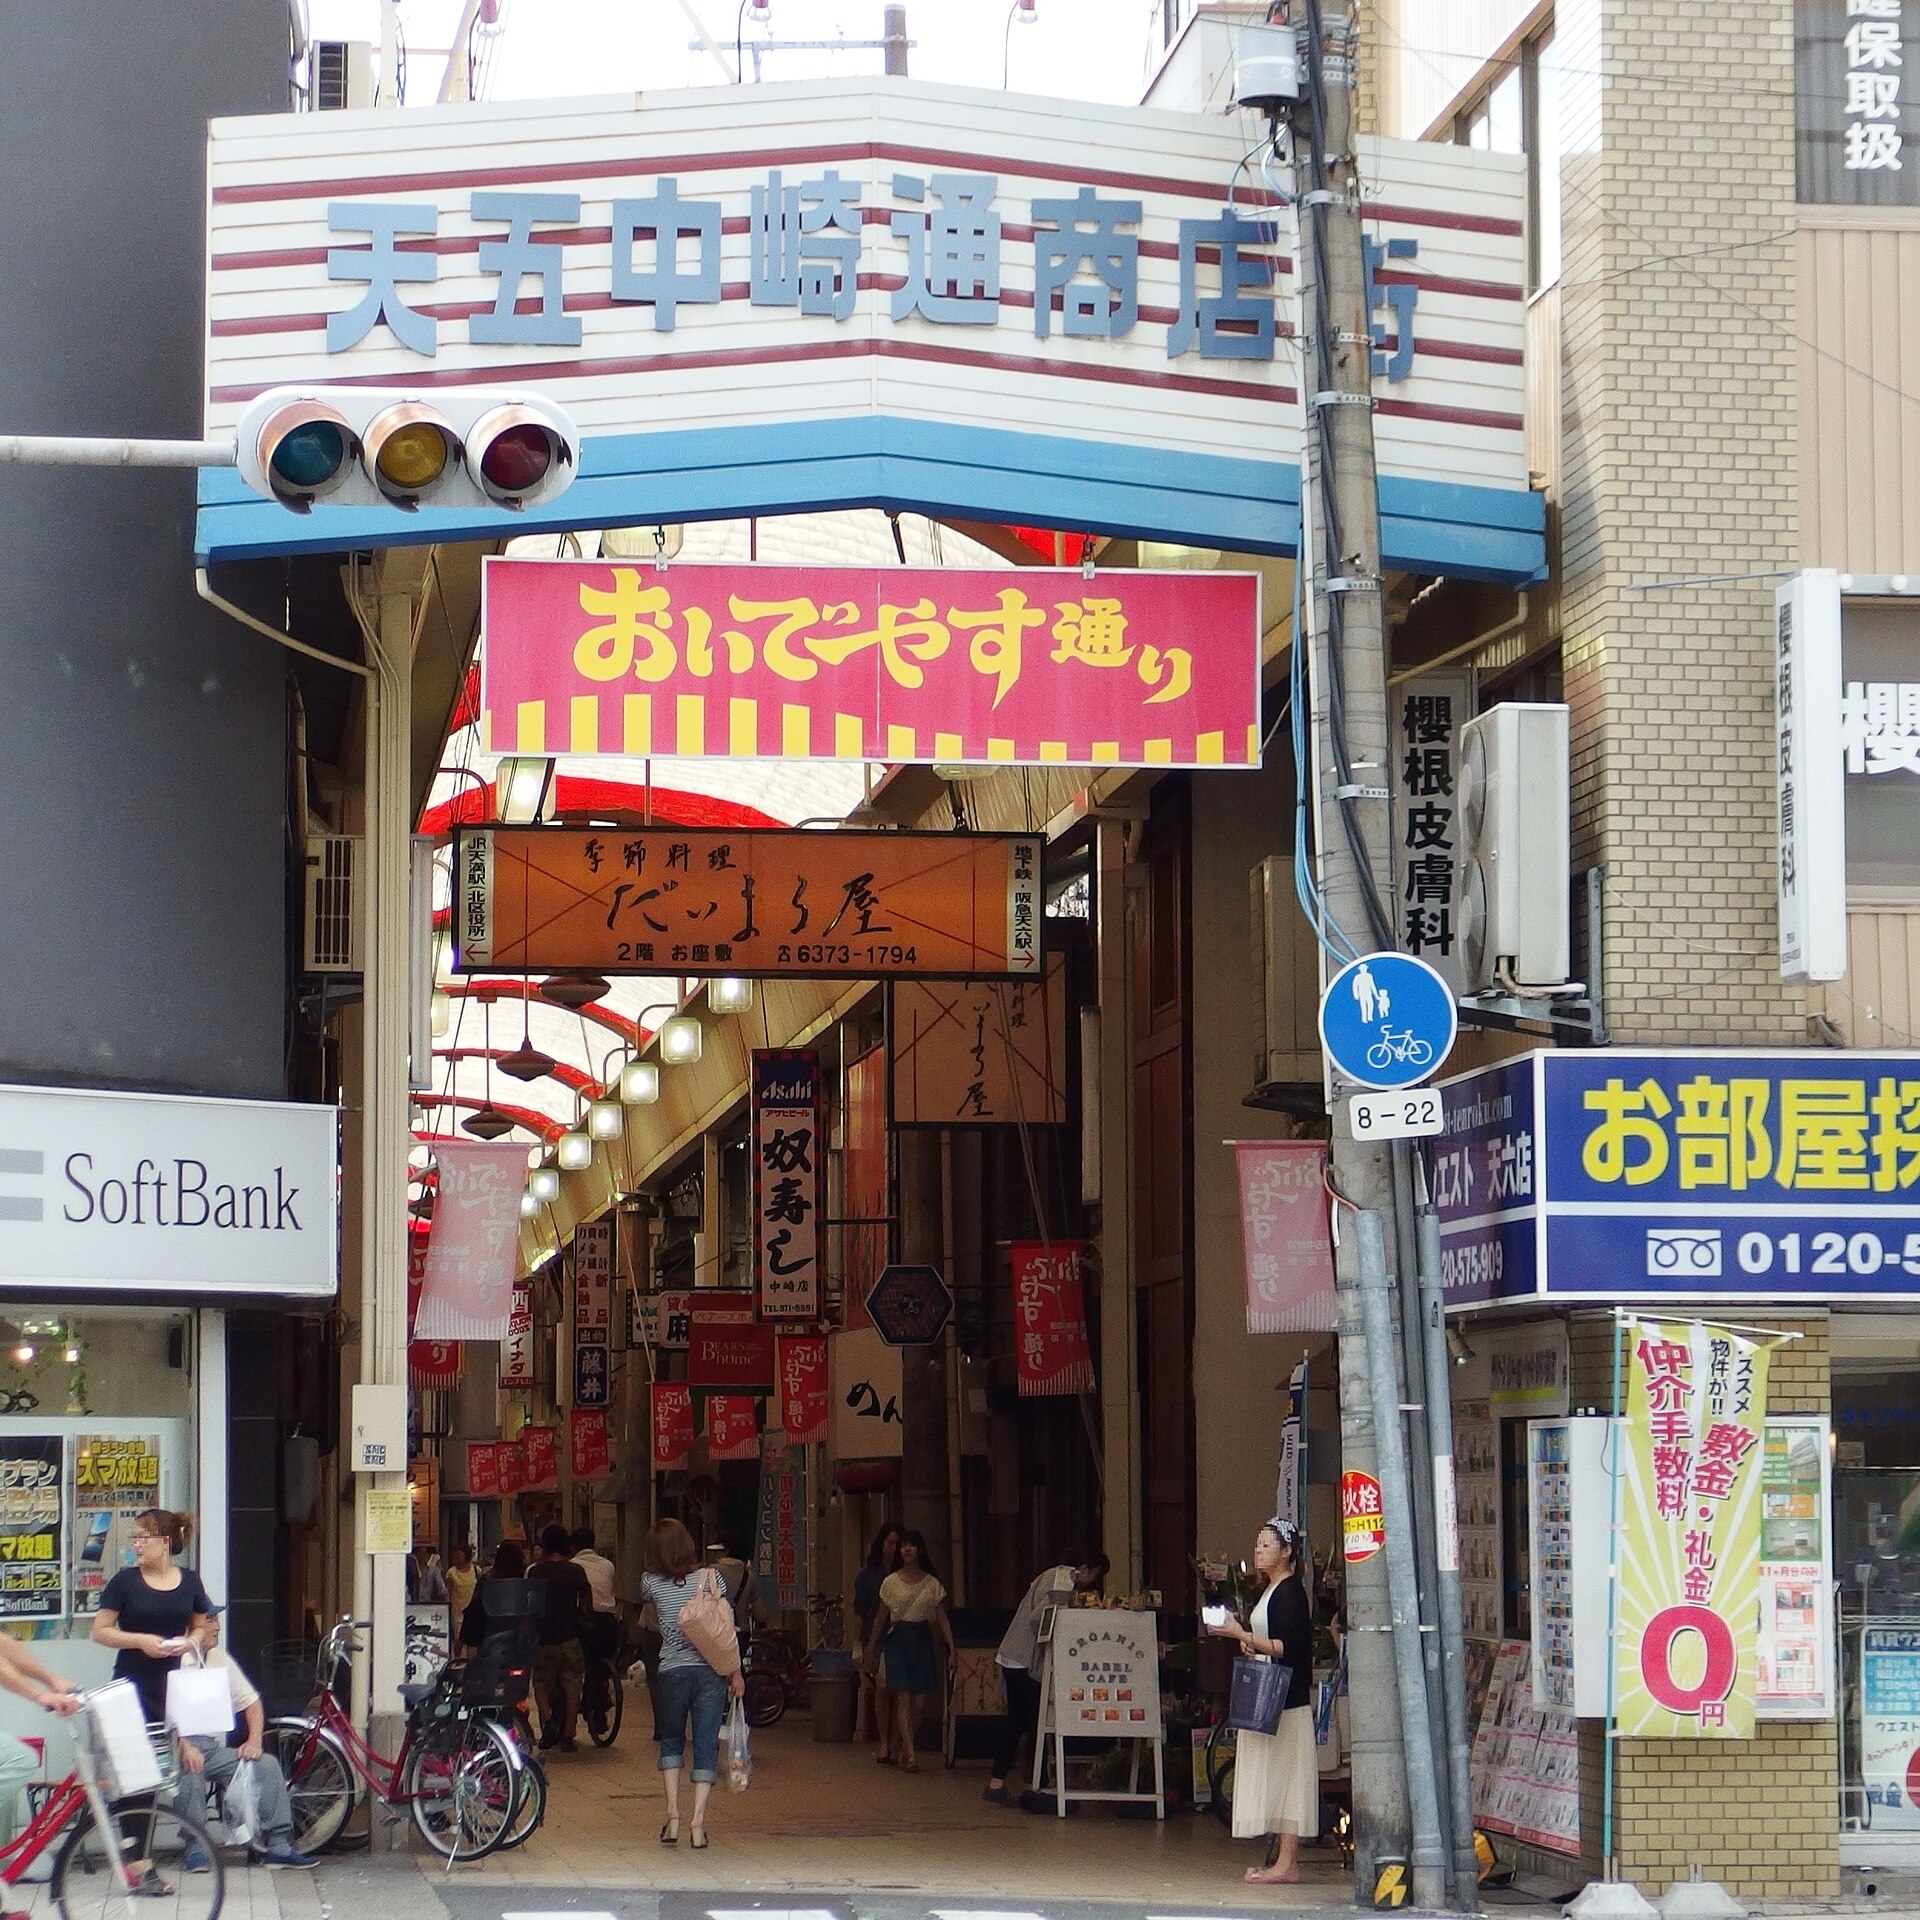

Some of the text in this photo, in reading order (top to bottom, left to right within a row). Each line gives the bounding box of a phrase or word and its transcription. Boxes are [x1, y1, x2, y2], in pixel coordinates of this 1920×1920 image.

[572, 567, 1192, 711] おいでやす通り
[1404, 696, 1455, 956] 櫻根皮膚科
[584, 838, 737, 876] 季節料理
[796, 945, 917, 964] 6373-1794
[63, 1153, 303, 1231] SoftBank
[509, 1336, 525, 1375] イナダ
[1733, 1350, 1754, 1415] ススメ
[1636, 1338, 1692, 1521] 仲介手数料
[0, 1459, 58, 1487] プラン
[77, 1456, 159, 1487] スマ放題
[0, 1486, 60, 1525] 登場
[1343, 1484, 1380, 1515] 火栓
[1684, 1423, 1758, 1604] 敷金・礼金
